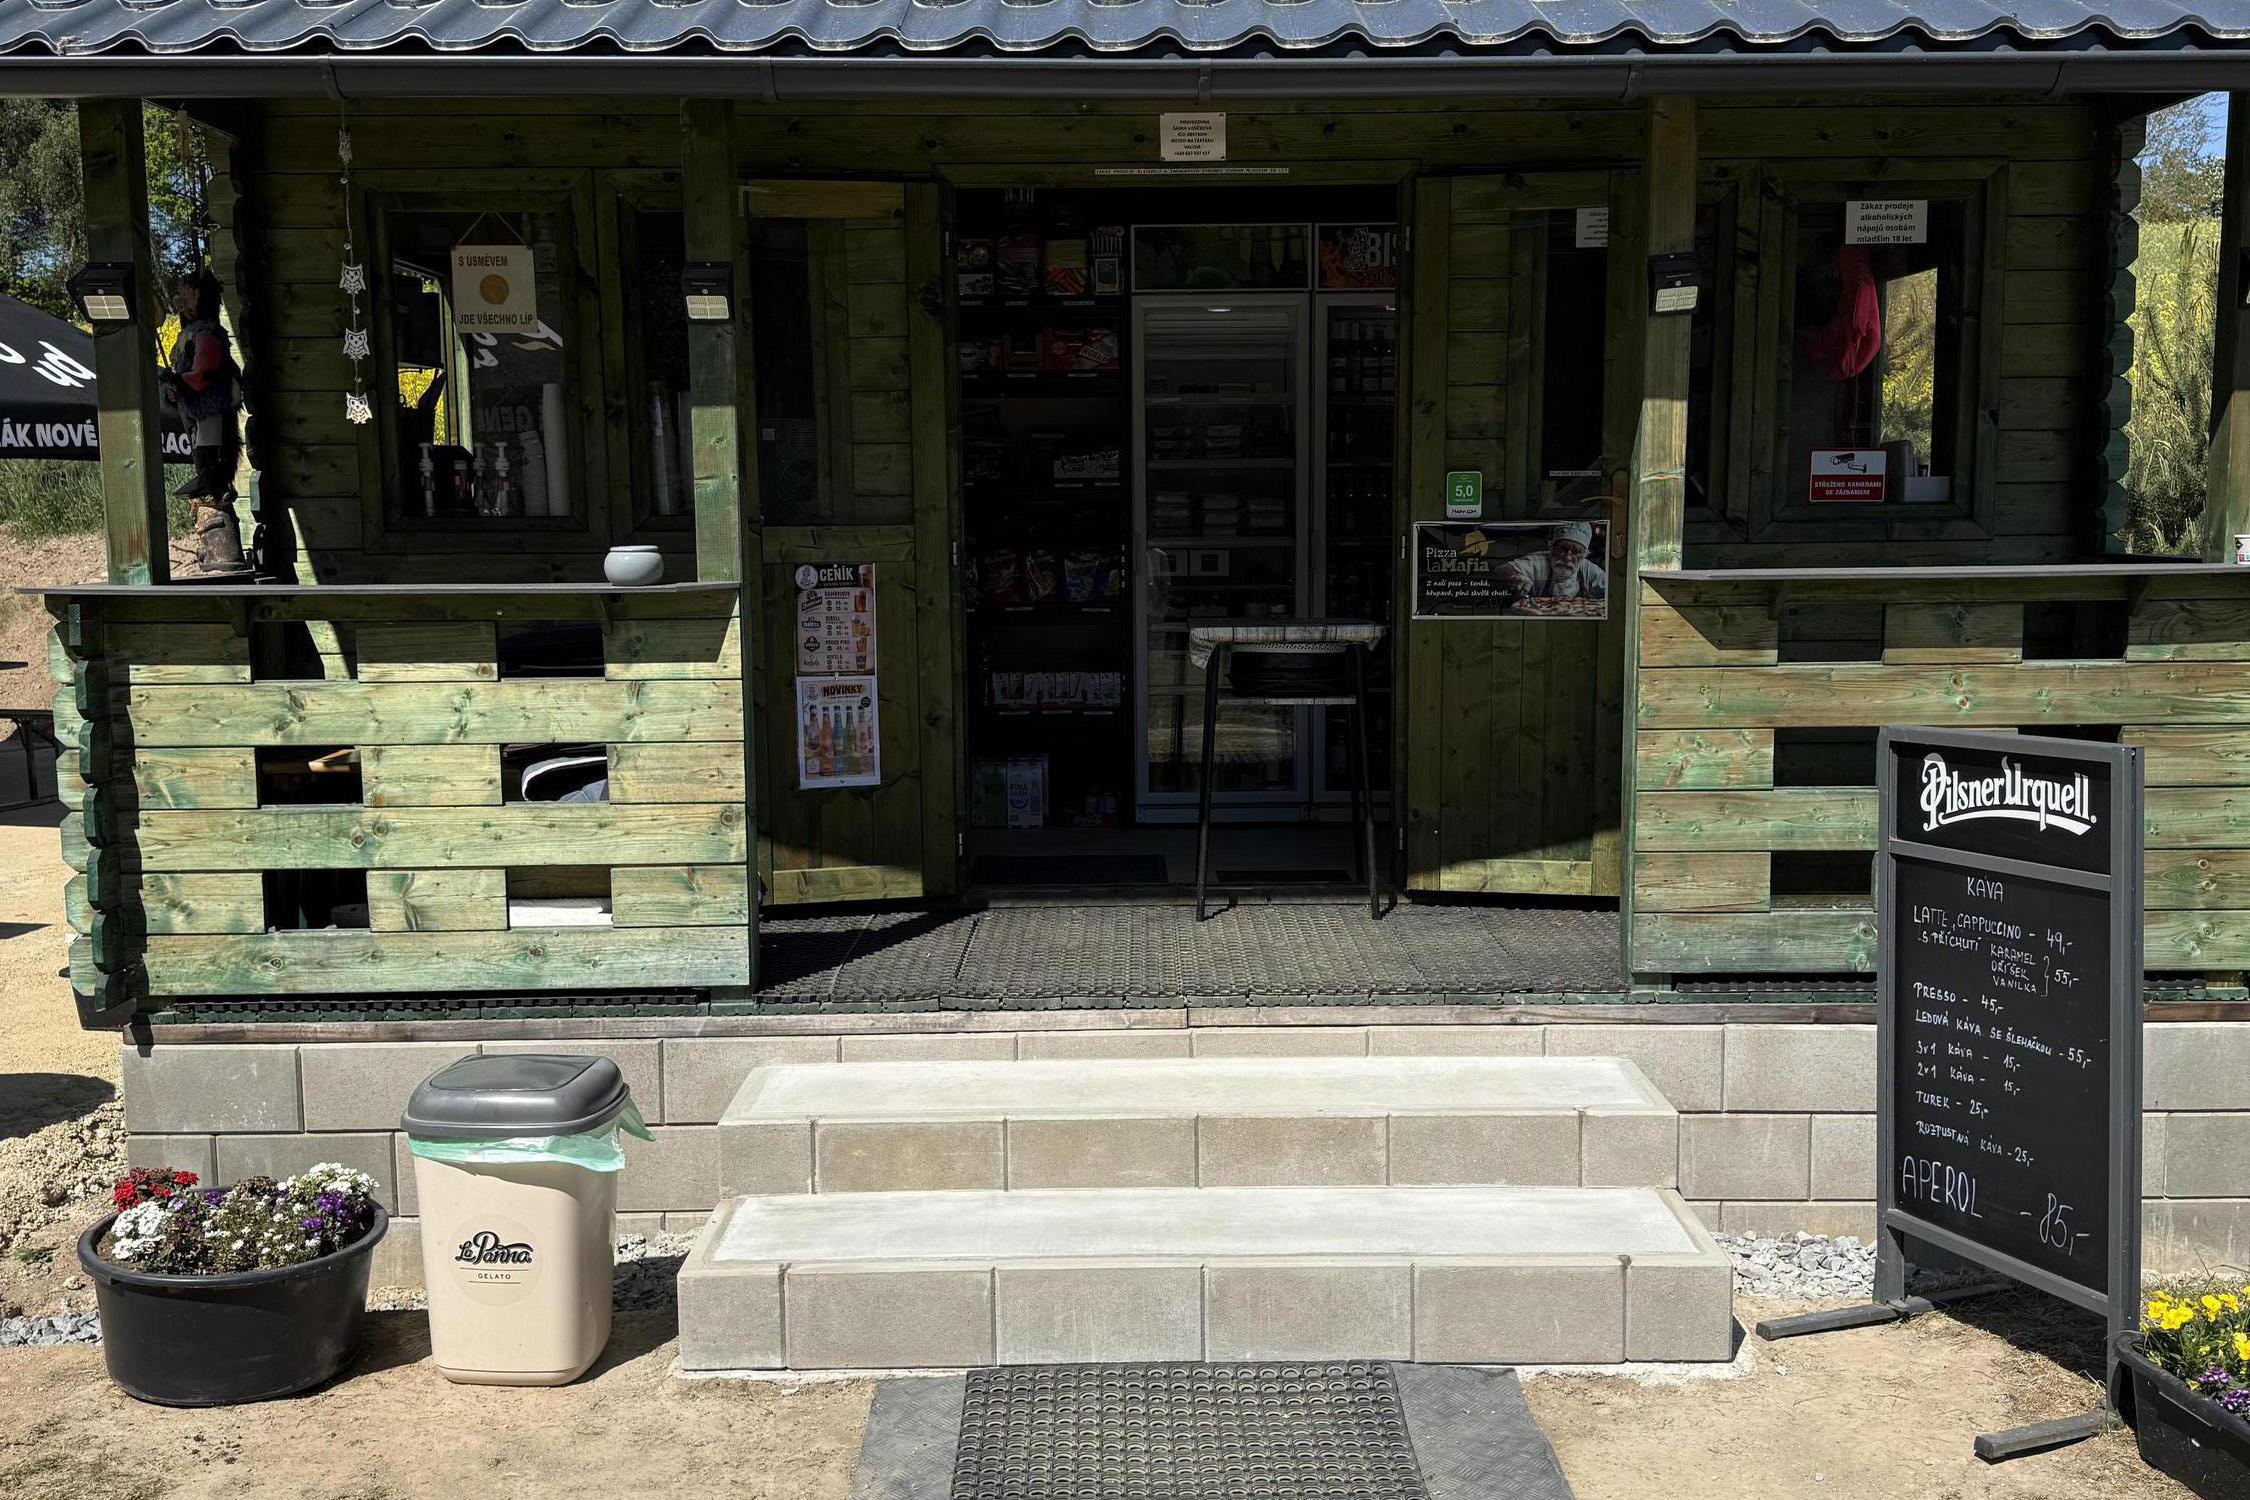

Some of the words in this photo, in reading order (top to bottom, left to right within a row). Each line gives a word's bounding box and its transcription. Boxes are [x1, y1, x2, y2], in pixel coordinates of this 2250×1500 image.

[1860, 202, 1883, 210] Zákaz
[1884, 202, 1914, 211] prodeje
[1860, 213, 1913, 222] alkoholických
[1856, 223, 1884, 233] nápojů
[458, 255, 464, 267] S
[465, 252, 508, 267] ÚSMĚVEM
[459, 313, 475, 325] JDE
[477, 311, 518, 325] VŠECHNO
[520, 312, 533, 325] LÍP
[0, 418, 34, 448] ÁK
[35, 419, 98, 448] NOVÉ
[1454, 485, 1473, 498] 5,0
[1425, 546, 1457, 558] Pizza
[820, 565, 854, 581] CENÍK
[822, 684, 863, 697] NOVINKY
[1920, 752, 2005, 831] Pilsner
[1966, 874, 2003, 903] KÁVA
[1990, 943, 2036, 966] KARAMEL
[2046, 928, 2073, 955] 49,-
[1991, 960, 2030, 981] OŘÍŠEK
[2054, 968, 2080, 988] 55,-
[1992, 975, 2037, 994] VANILKA
[1913, 981, 1956, 1003] PRESSO
[1981, 994, 2005, 1015] 45,-
[1915, 1008, 1949, 1026] LEDOVÁ
[1956, 1016, 1982, 1036] KÁVA
[1990, 1026, 2002, 1040] SE
[2005, 1026, 2052, 1056] ŠLEHAČKOU
[2067, 1047, 2092, 1069] 55,-
[1916, 1040, 1936, 1055] 3v1
[1948, 1042, 1973, 1060] KÁVA
[2003, 1054, 2021, 1072] 15,-
[1917, 1062, 1936, 1079] 2v1
[1950, 1066, 1975, 1084] KÁVA
[2003, 1080, 2021, 1096] 15,-
[1915, 1090, 1950, 1109] TUREK
[1970, 1099, 1989, 1119] 25,-
[1915, 1120, 1970, 1146] ROZPUSTNÁ
[1980, 1134, 2002, 1156] KÁVA
[2015, 1146, 2034, 1167] 25,-
[1902, 1155, 1983, 1219] APEROL
[2039, 1192, 2090, 1256] 85,-
[455, 1240, 477, 1262] La
[472, 1230, 534, 1265] Panna
